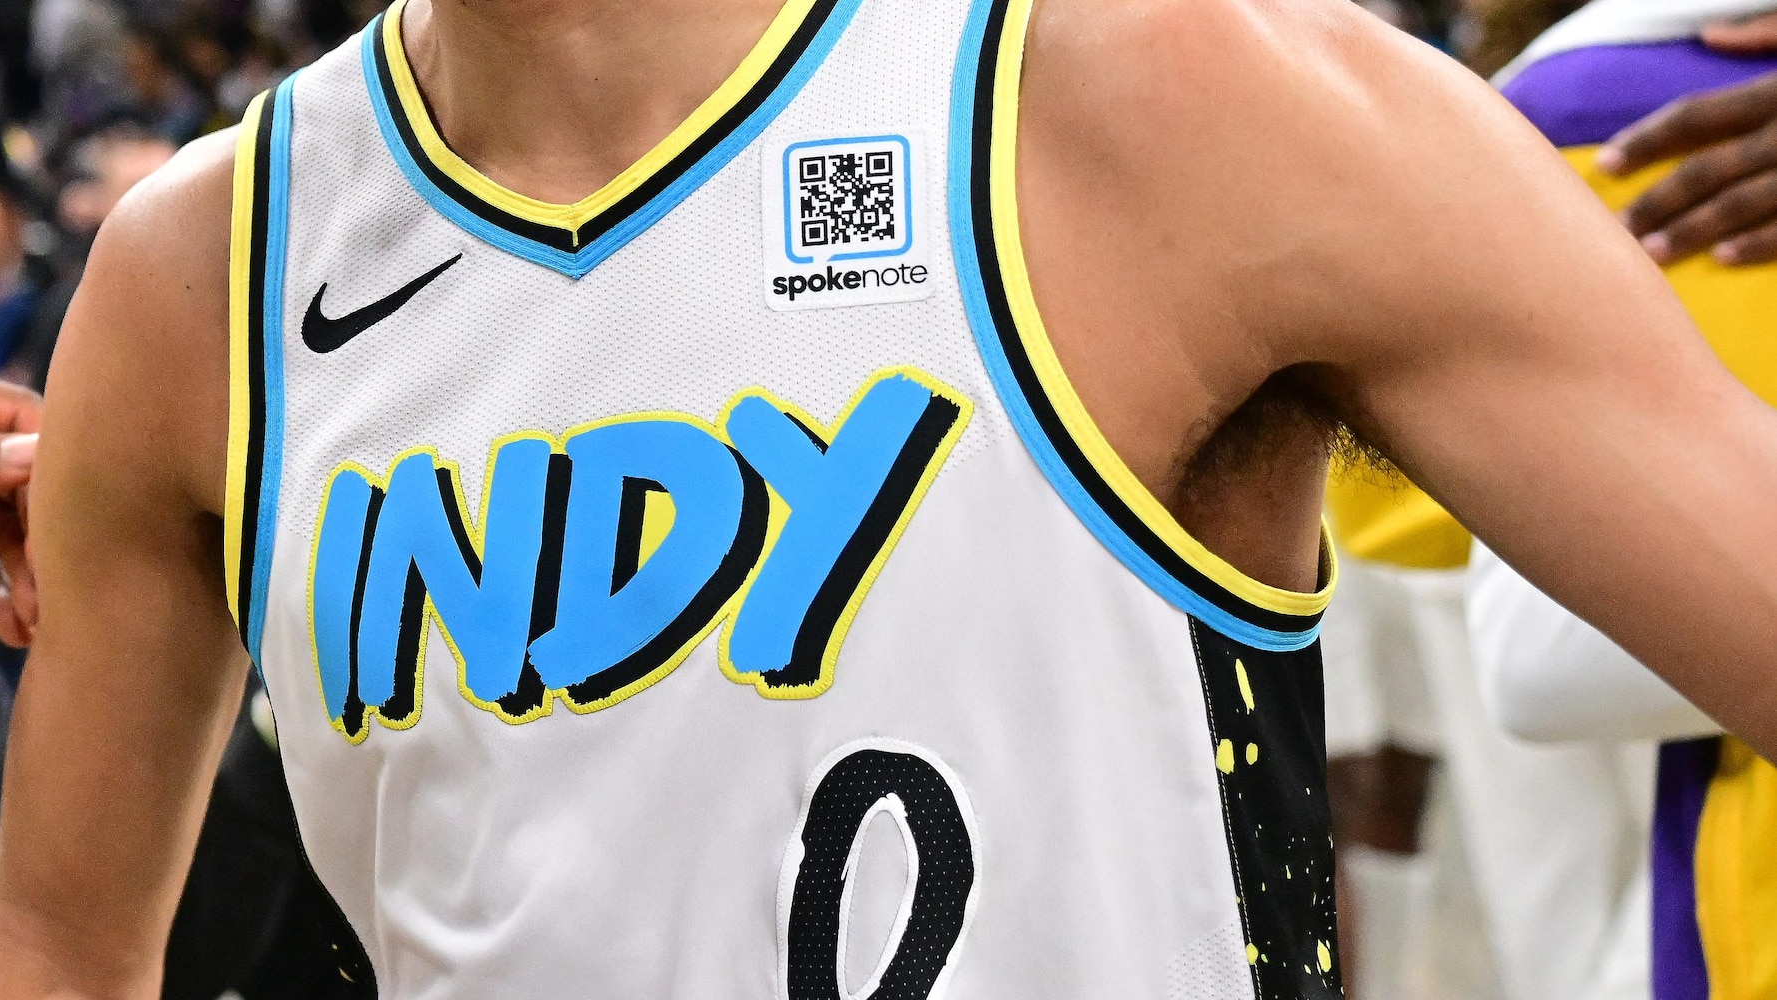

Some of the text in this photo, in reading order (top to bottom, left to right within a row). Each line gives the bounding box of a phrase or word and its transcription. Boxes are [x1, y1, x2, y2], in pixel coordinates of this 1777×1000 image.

[773, 263, 928, 301] spokenote
[307, 366, 975, 744] INDY
[781, 742, 979, 1000] 0
